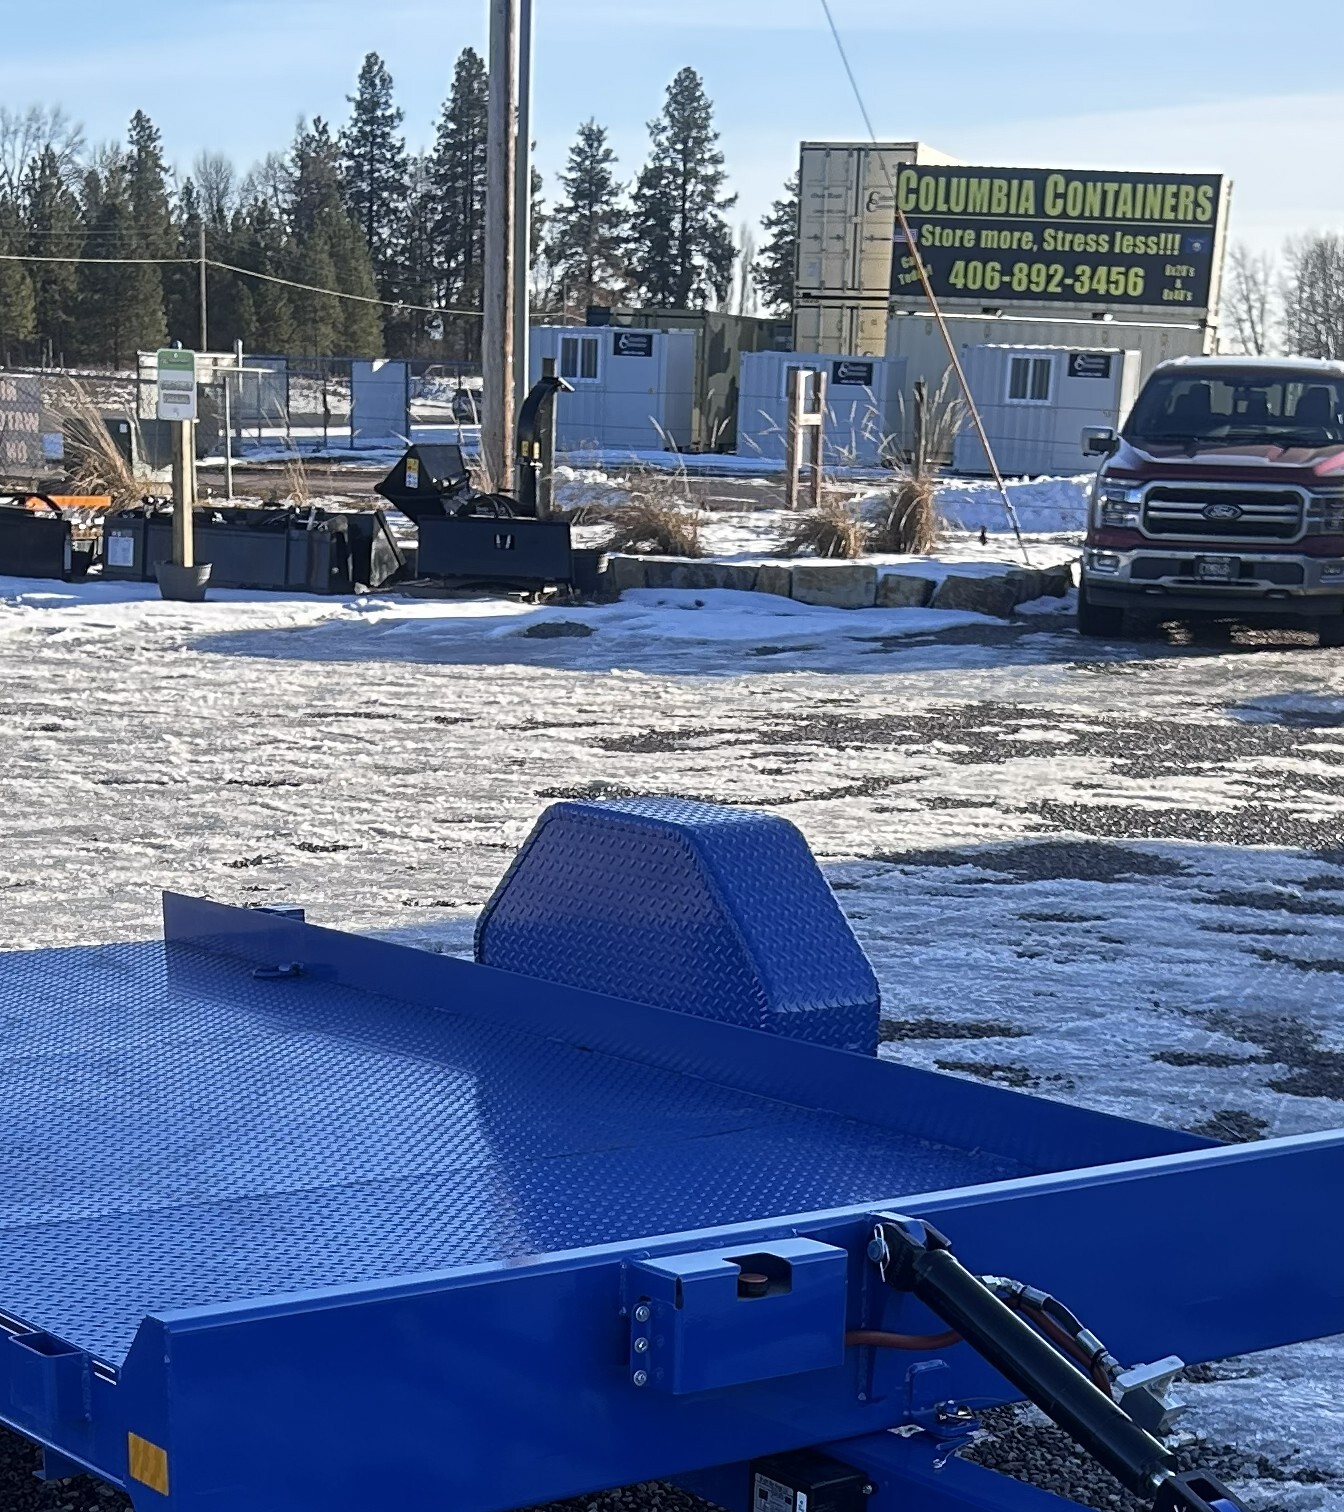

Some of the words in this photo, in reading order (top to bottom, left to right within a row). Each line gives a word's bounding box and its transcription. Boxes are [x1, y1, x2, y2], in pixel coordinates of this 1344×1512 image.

[897, 169, 1036, 215] COLUMBIA
[1043, 174, 1214, 222] CONTAINERS
[920, 224, 976, 248] Store
[980, 228, 1038, 252] more,
[1042, 228, 1109, 253] Stress
[1114, 231, 1182, 256] less!!!
[948, 260, 1145, 297] 406-892-3456
